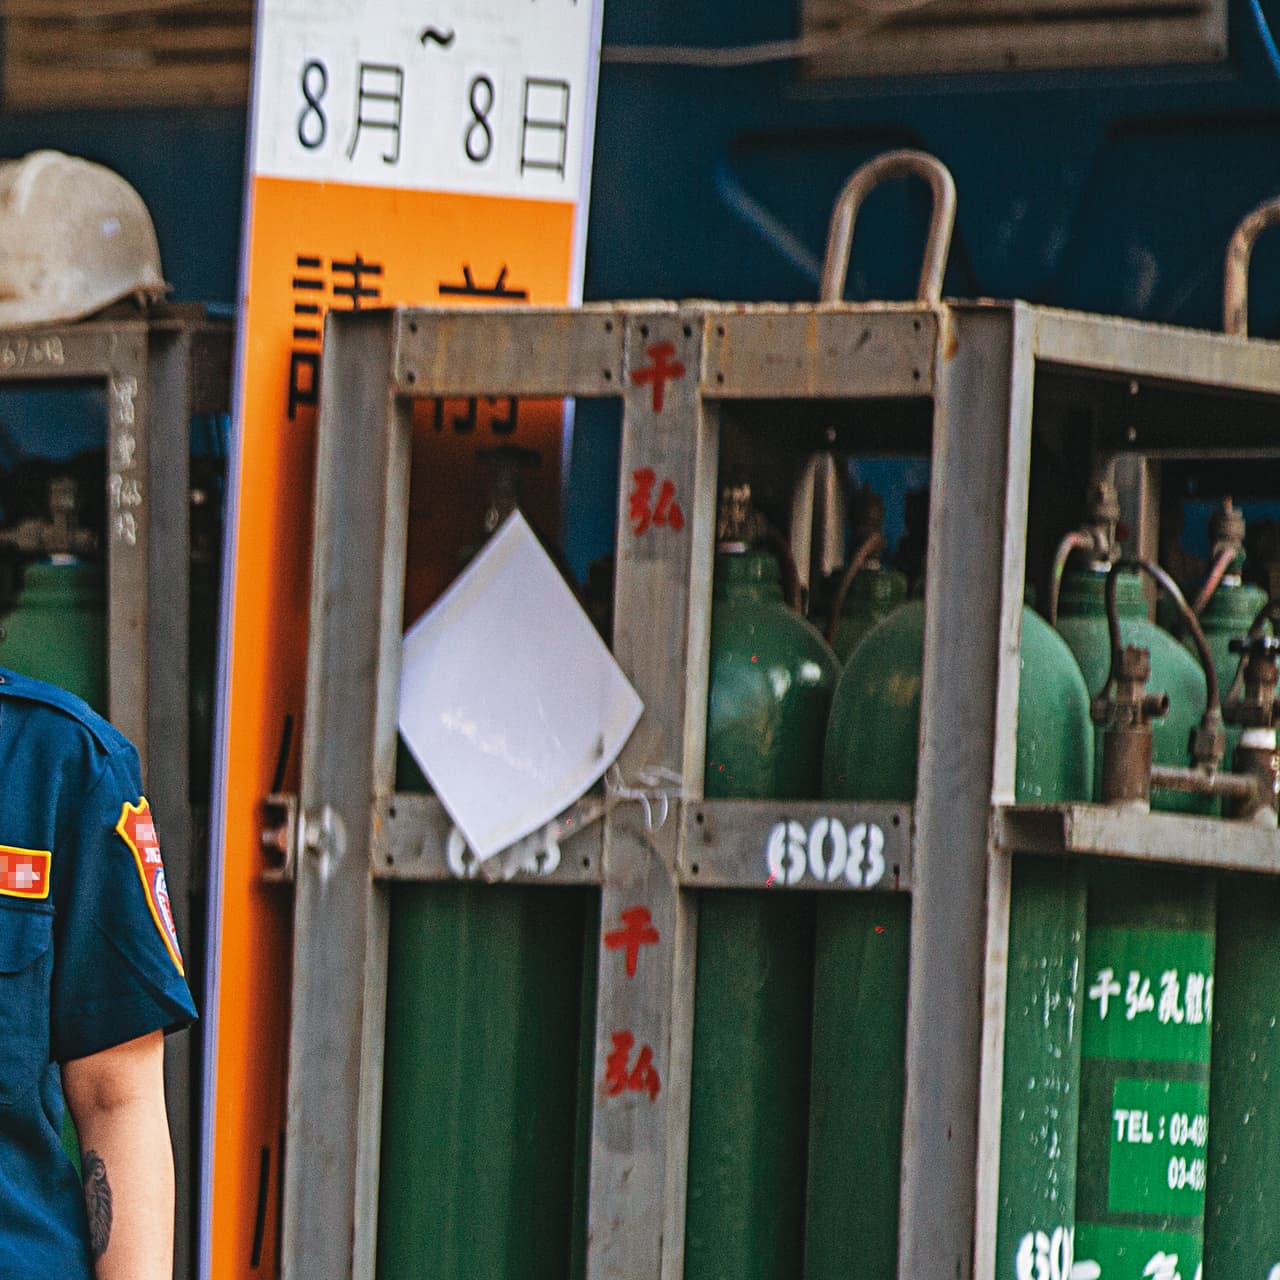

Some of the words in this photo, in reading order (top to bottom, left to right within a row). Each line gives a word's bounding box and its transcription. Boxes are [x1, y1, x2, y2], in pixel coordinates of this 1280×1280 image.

[297, 60, 403, 163] 8月
[464, 75, 569, 180] 8日
[768, 817, 885, 887] 608
